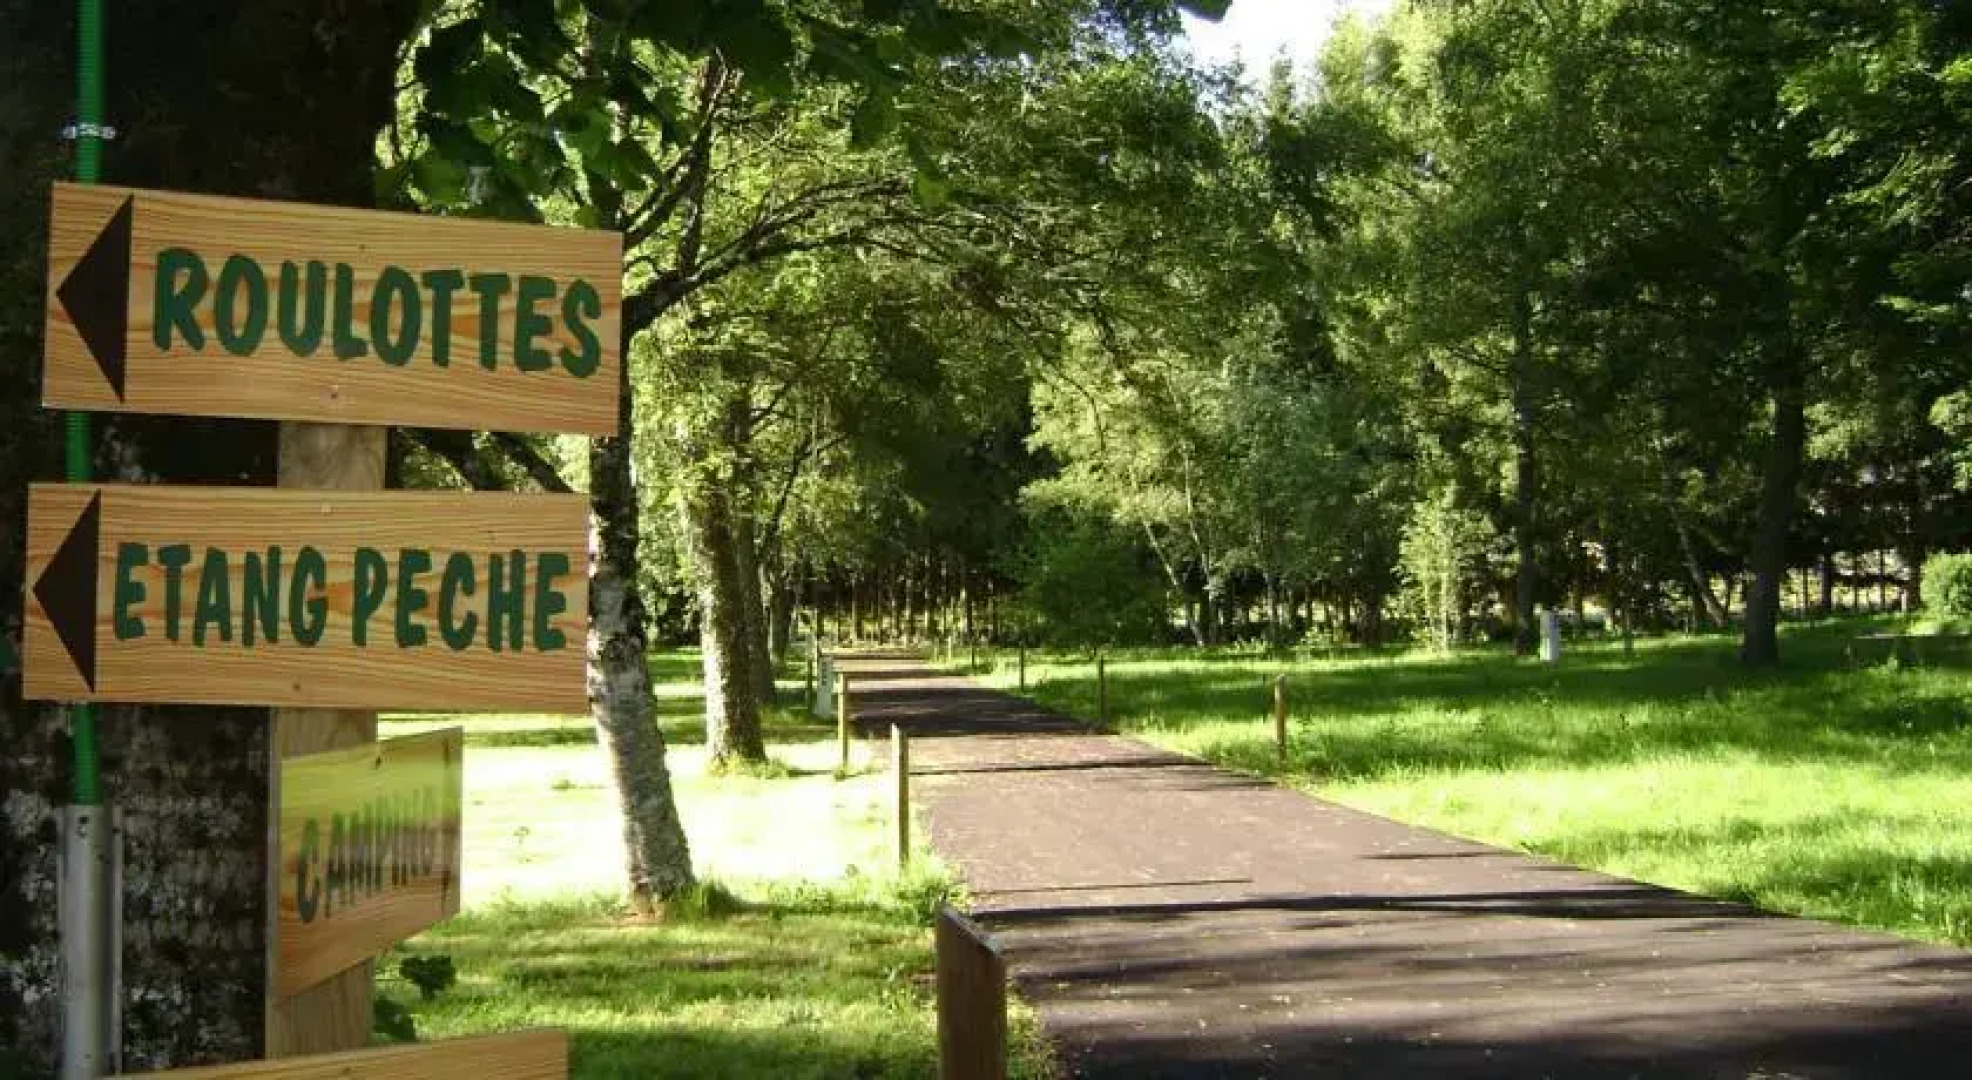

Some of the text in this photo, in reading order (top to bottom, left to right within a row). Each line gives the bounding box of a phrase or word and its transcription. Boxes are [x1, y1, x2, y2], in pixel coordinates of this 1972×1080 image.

[152, 247, 601, 378] ROULOTTES
[113, 542, 570, 651] ETANG PECHE
